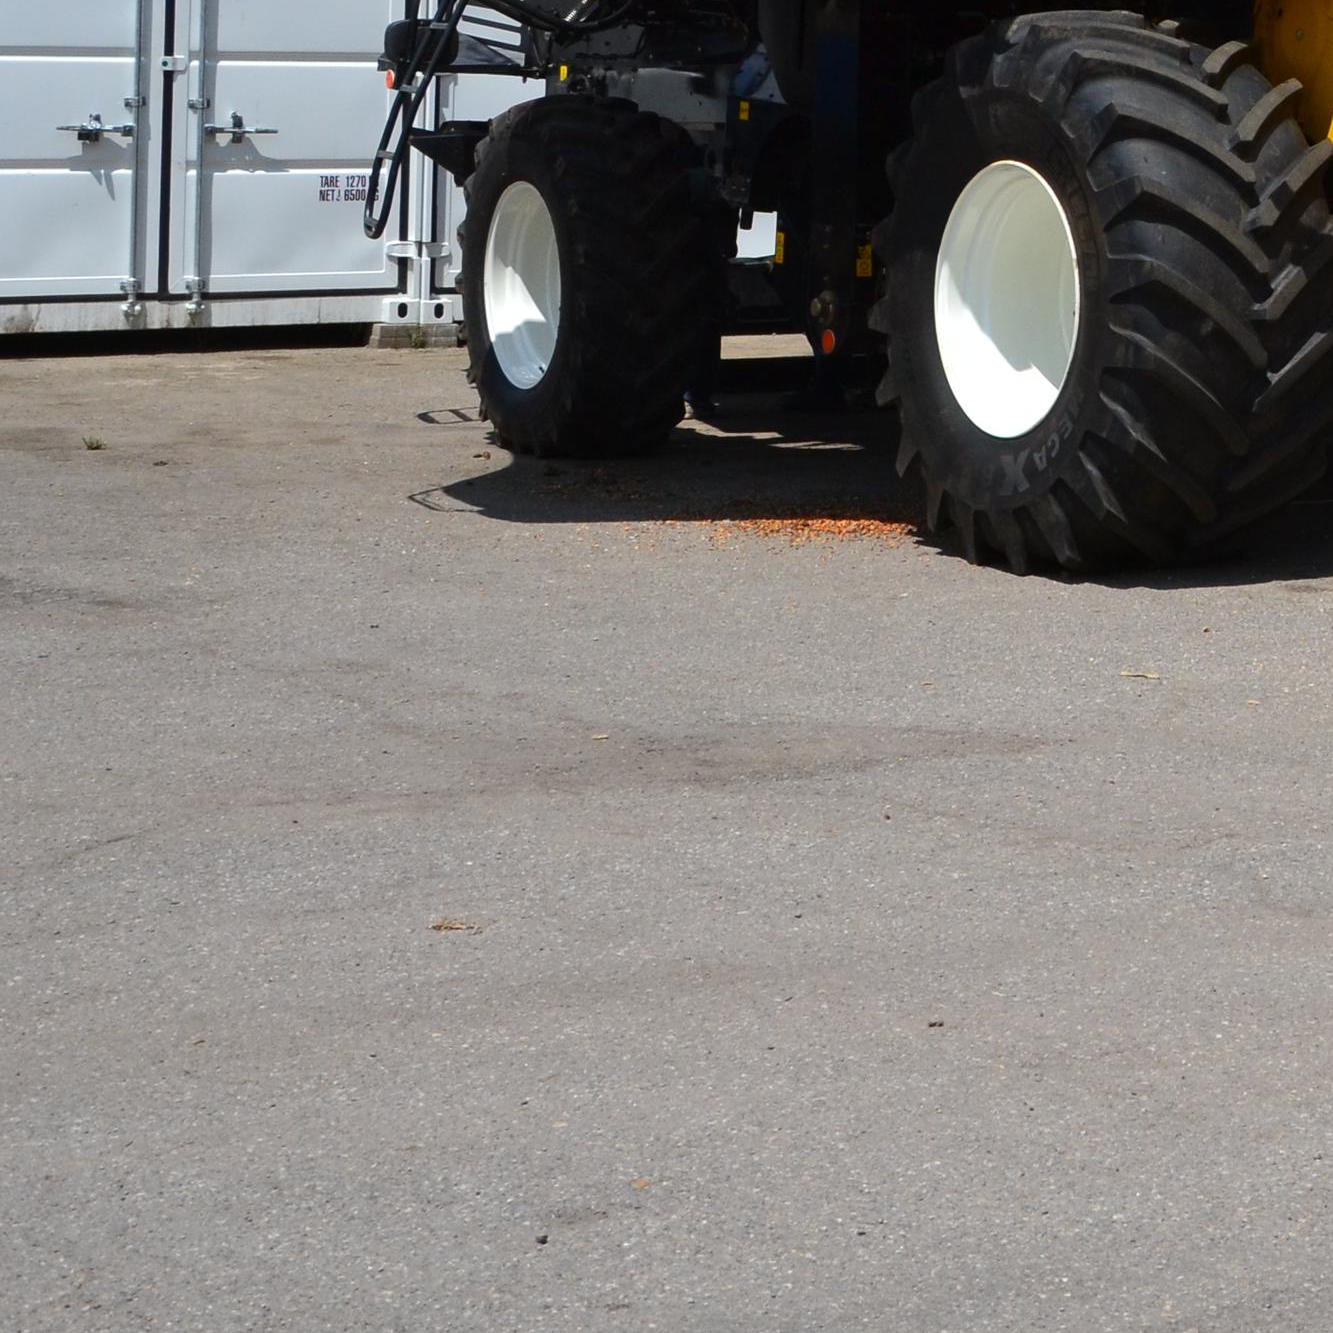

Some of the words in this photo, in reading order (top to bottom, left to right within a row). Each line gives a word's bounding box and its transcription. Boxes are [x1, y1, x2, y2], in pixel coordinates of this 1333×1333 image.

[319, 175, 340, 188] TARE
[345, 175, 367, 188] 1270
[344, 189, 366, 202] 6500
